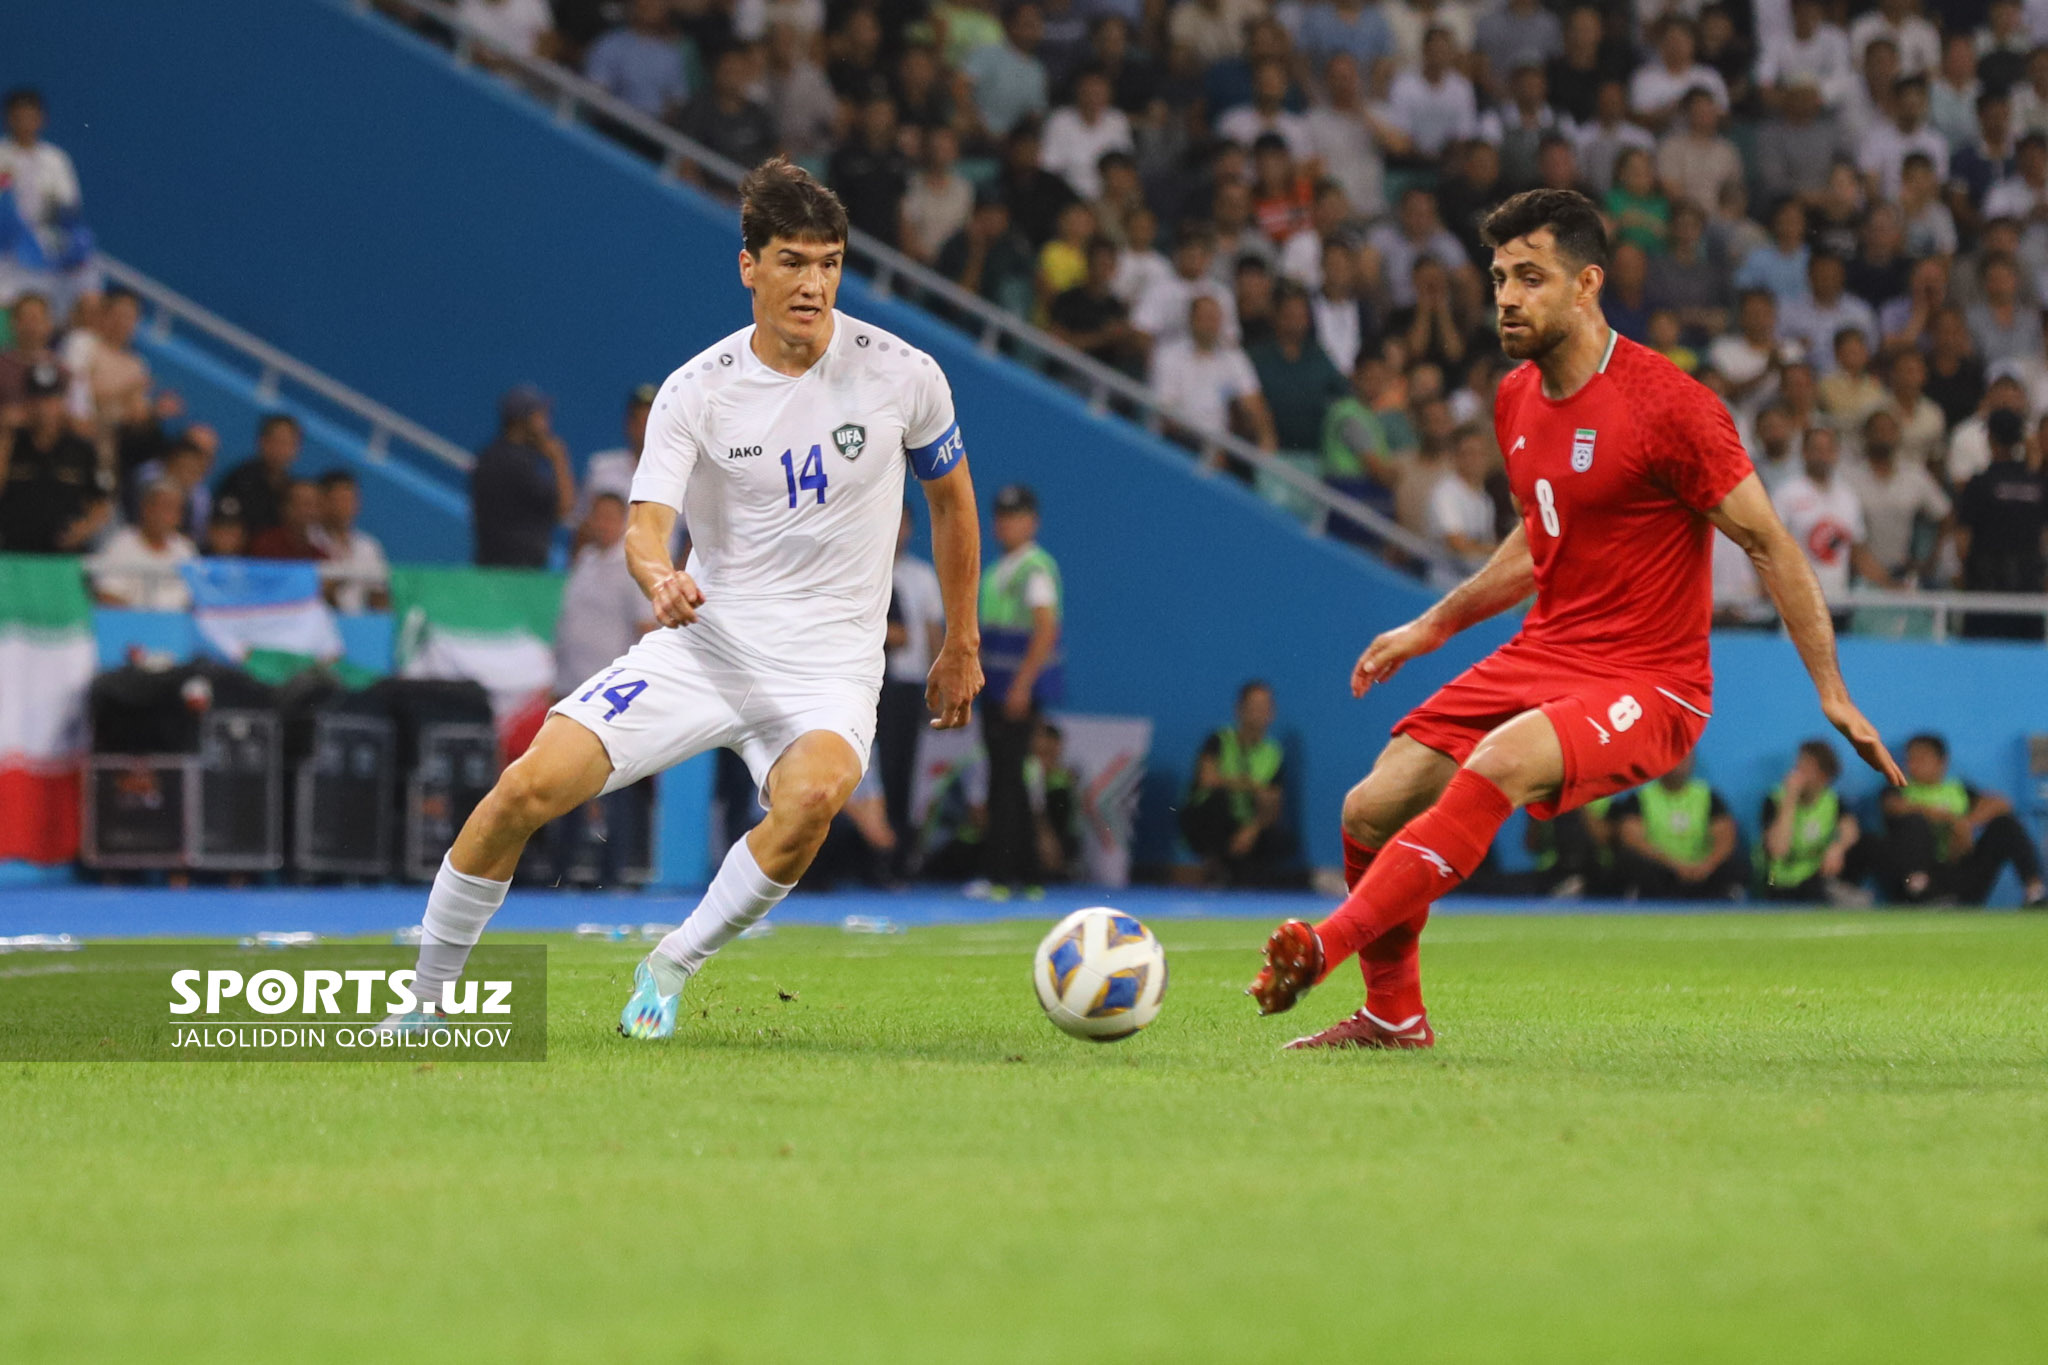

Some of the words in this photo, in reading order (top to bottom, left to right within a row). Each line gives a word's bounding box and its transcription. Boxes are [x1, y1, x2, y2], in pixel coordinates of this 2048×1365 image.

[728, 445, 763, 459] JAKO
[836, 429, 864, 445] UFA
[780, 444, 828, 508] 14
[1534, 478, 1560, 537] 8
[579, 668, 649, 722] 14
[1608, 695, 1643, 732] 8
